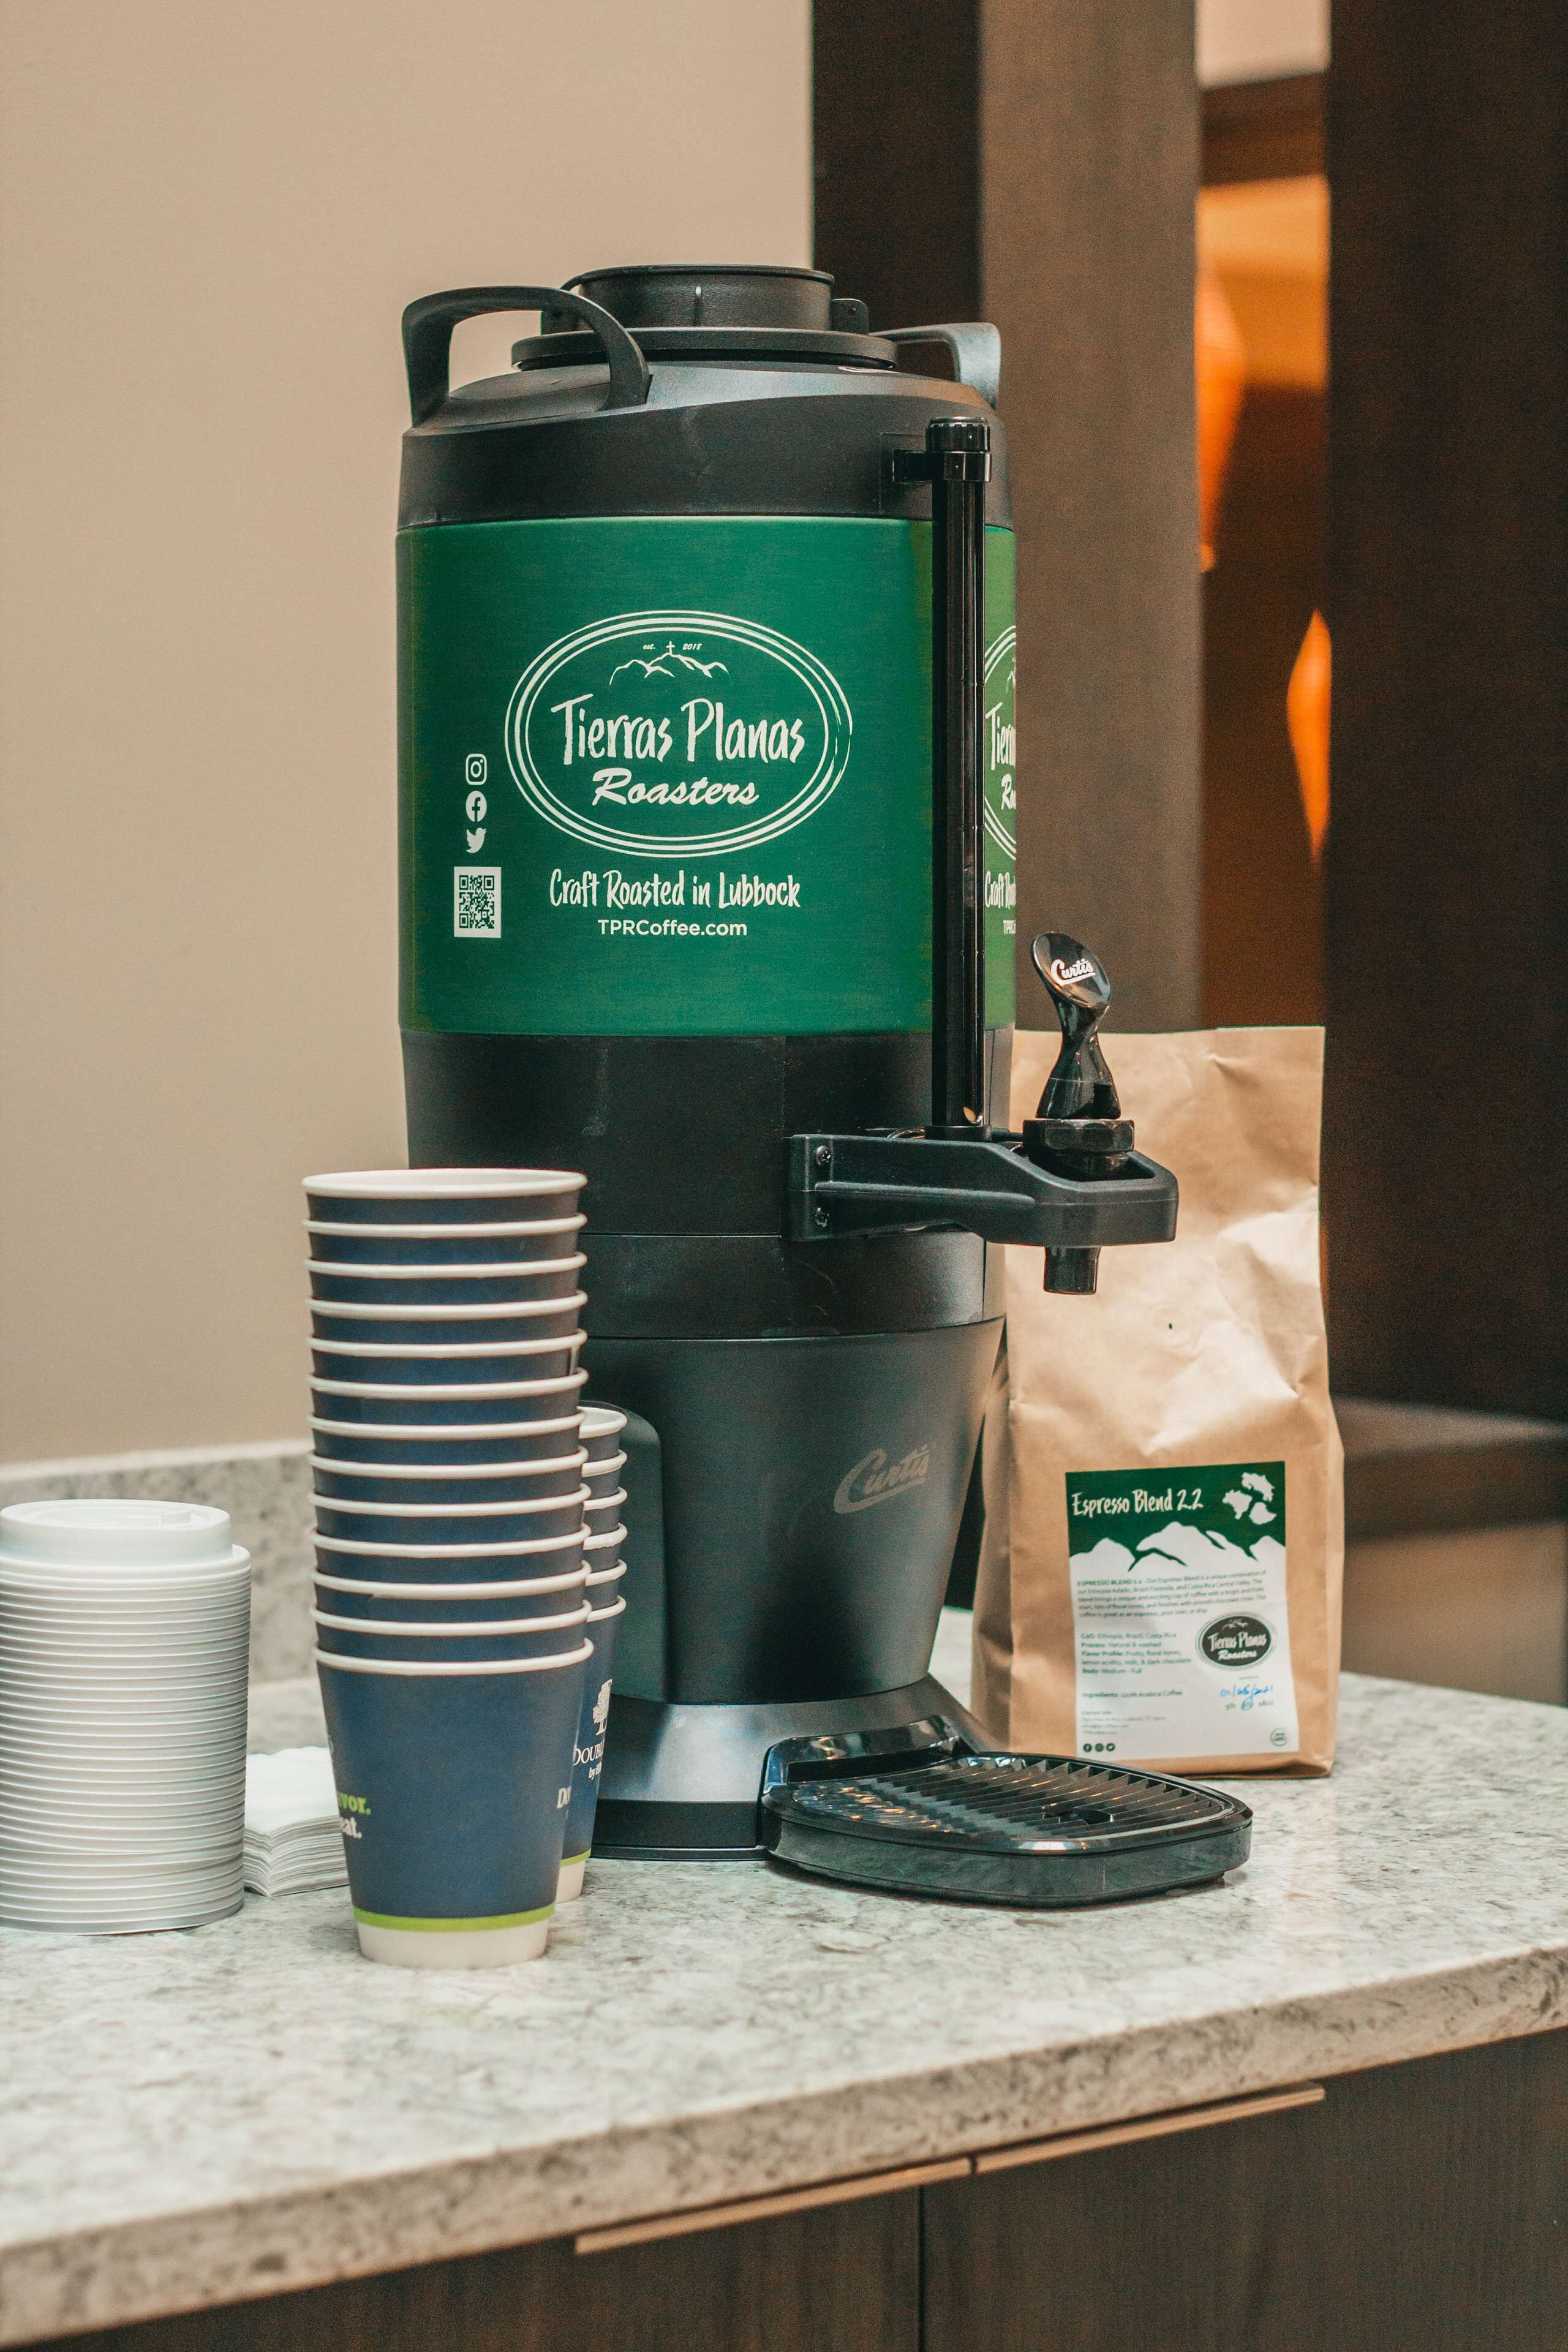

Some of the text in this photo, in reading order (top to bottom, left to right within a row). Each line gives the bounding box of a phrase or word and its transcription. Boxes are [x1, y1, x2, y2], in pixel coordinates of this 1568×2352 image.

[551, 693, 805, 765] Tierras Planas
[592, 768, 759, 805] Roasters
[550, 869, 801, 908] Craft Roasted in Lubbock
[598, 919, 747, 935] TPRCoffee.com
[1050, 958, 1096, 986] Curtis
[1071, 1488, 1204, 1518] Espresso Blend 2.2
